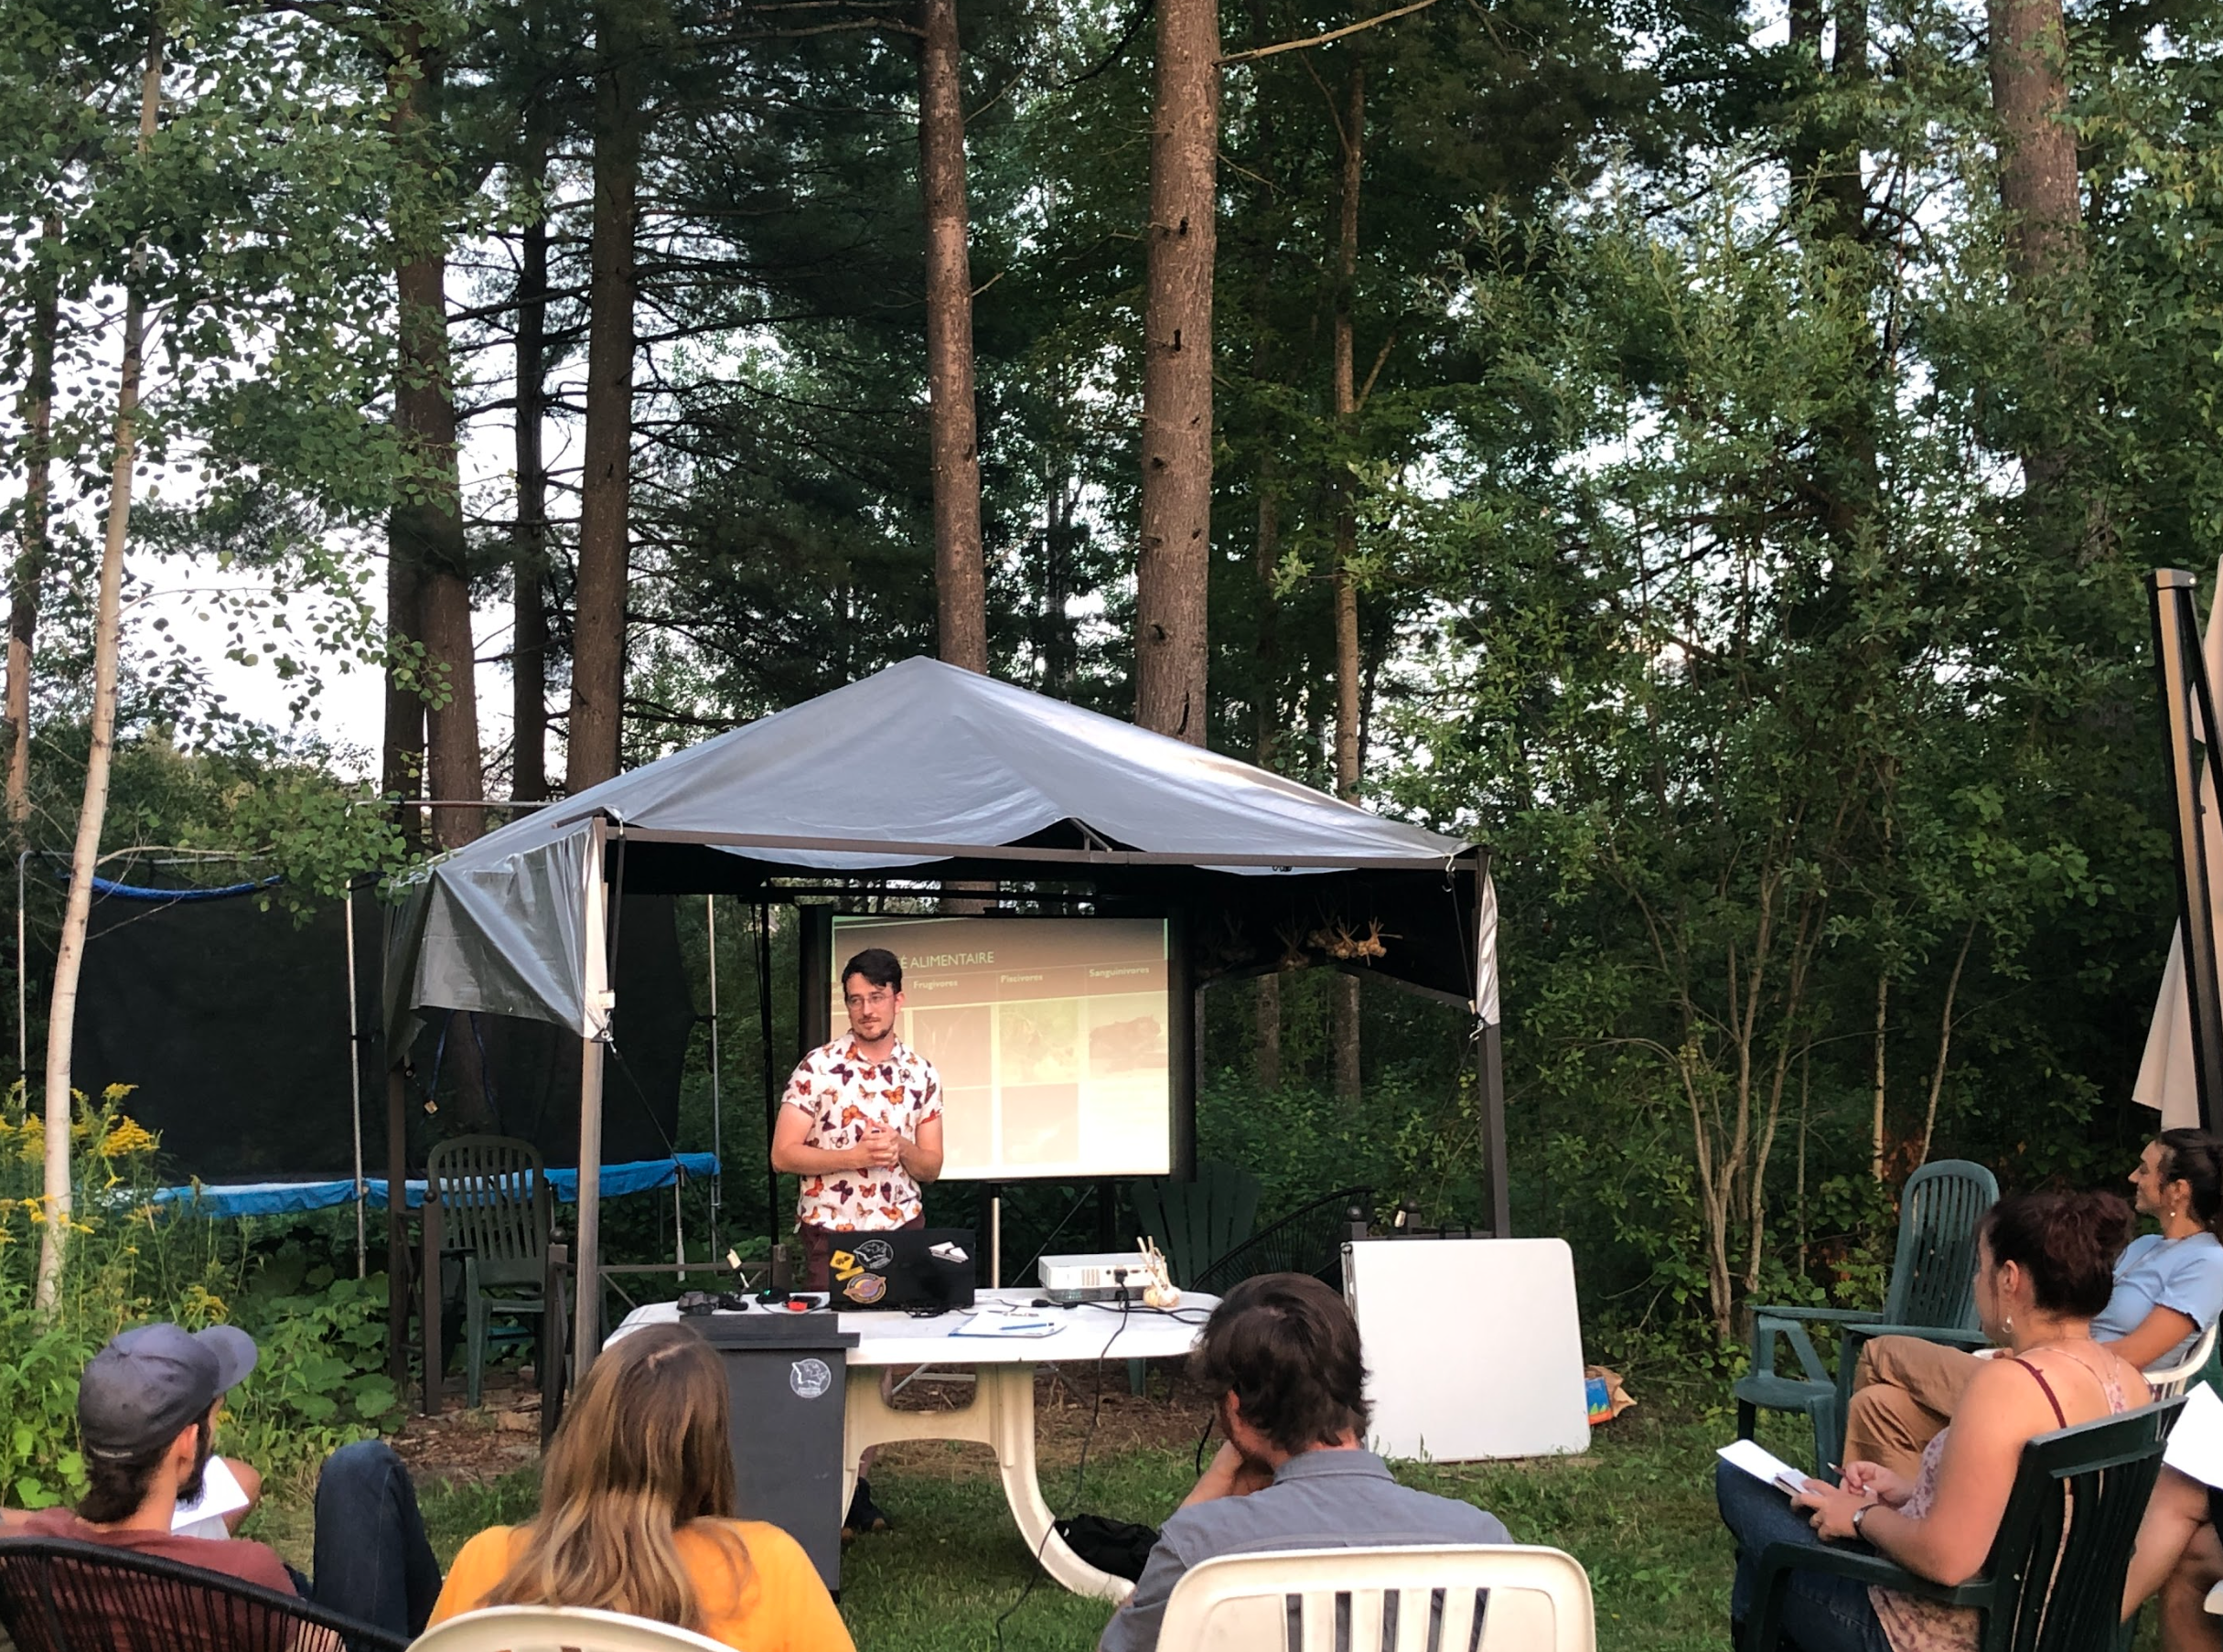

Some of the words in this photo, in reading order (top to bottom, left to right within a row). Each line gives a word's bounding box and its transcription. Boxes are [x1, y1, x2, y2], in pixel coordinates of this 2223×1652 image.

[909, 951, 994, 969] ALIMENTAIRE
[1000, 973, 1043, 983] Piscivores
[1089, 967, 1150, 979] Sanguinivores
[913, 980, 958, 991] Frugivores
